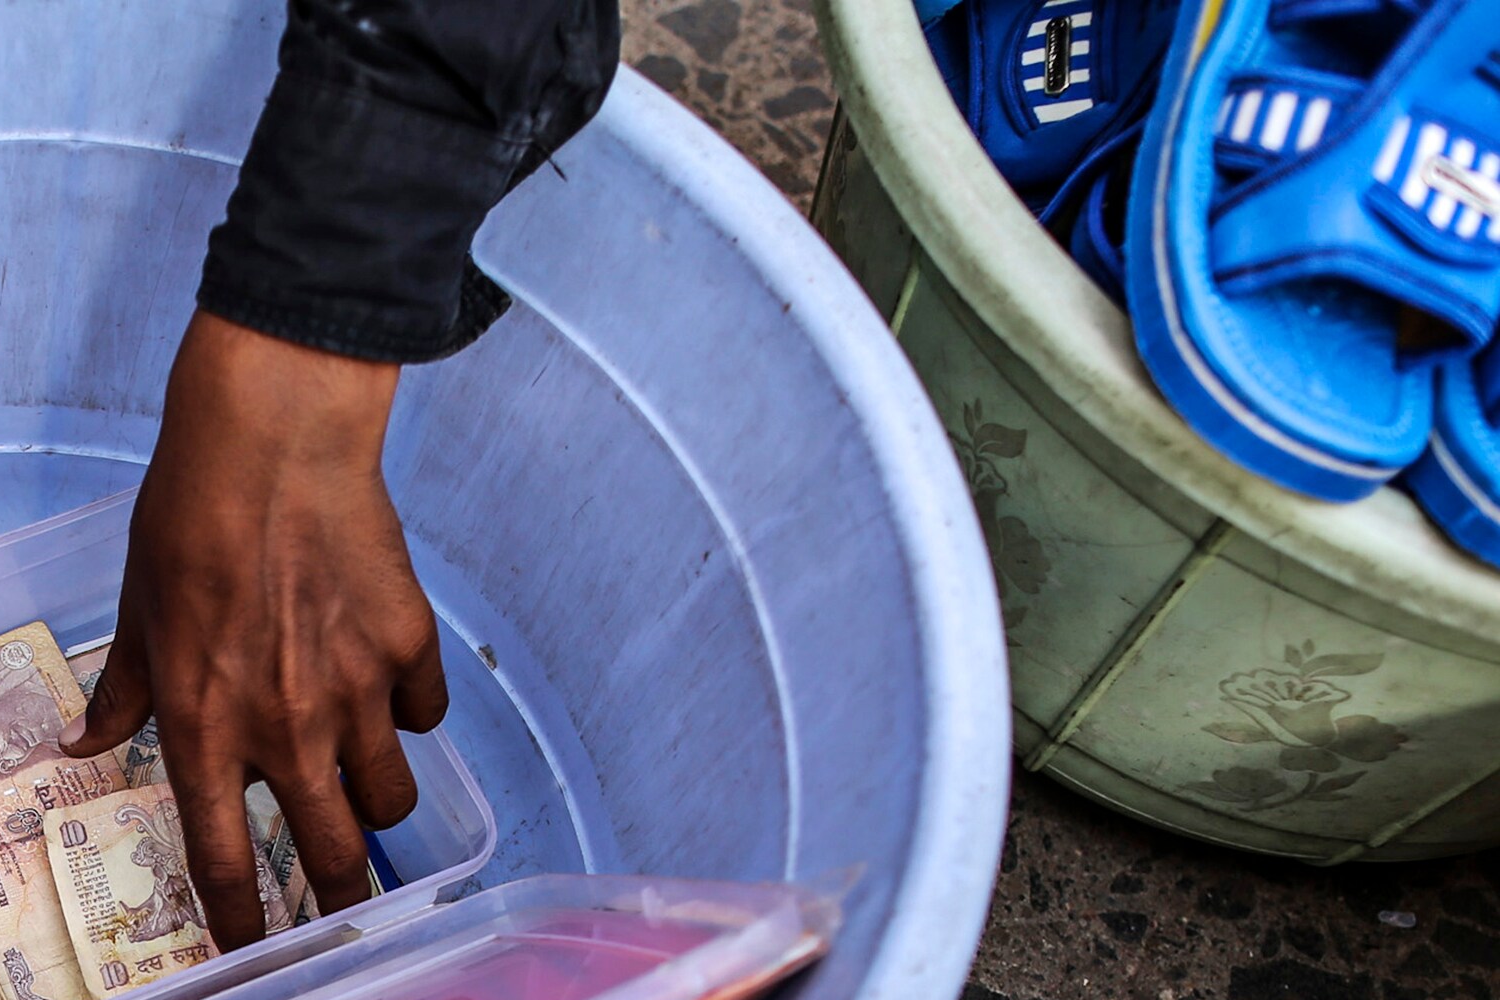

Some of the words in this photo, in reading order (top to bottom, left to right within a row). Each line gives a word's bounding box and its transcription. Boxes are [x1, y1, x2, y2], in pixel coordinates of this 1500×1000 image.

[59, 819, 87, 848] 10
[100, 960, 130, 990] 10
[136, 954, 164, 973] दस
